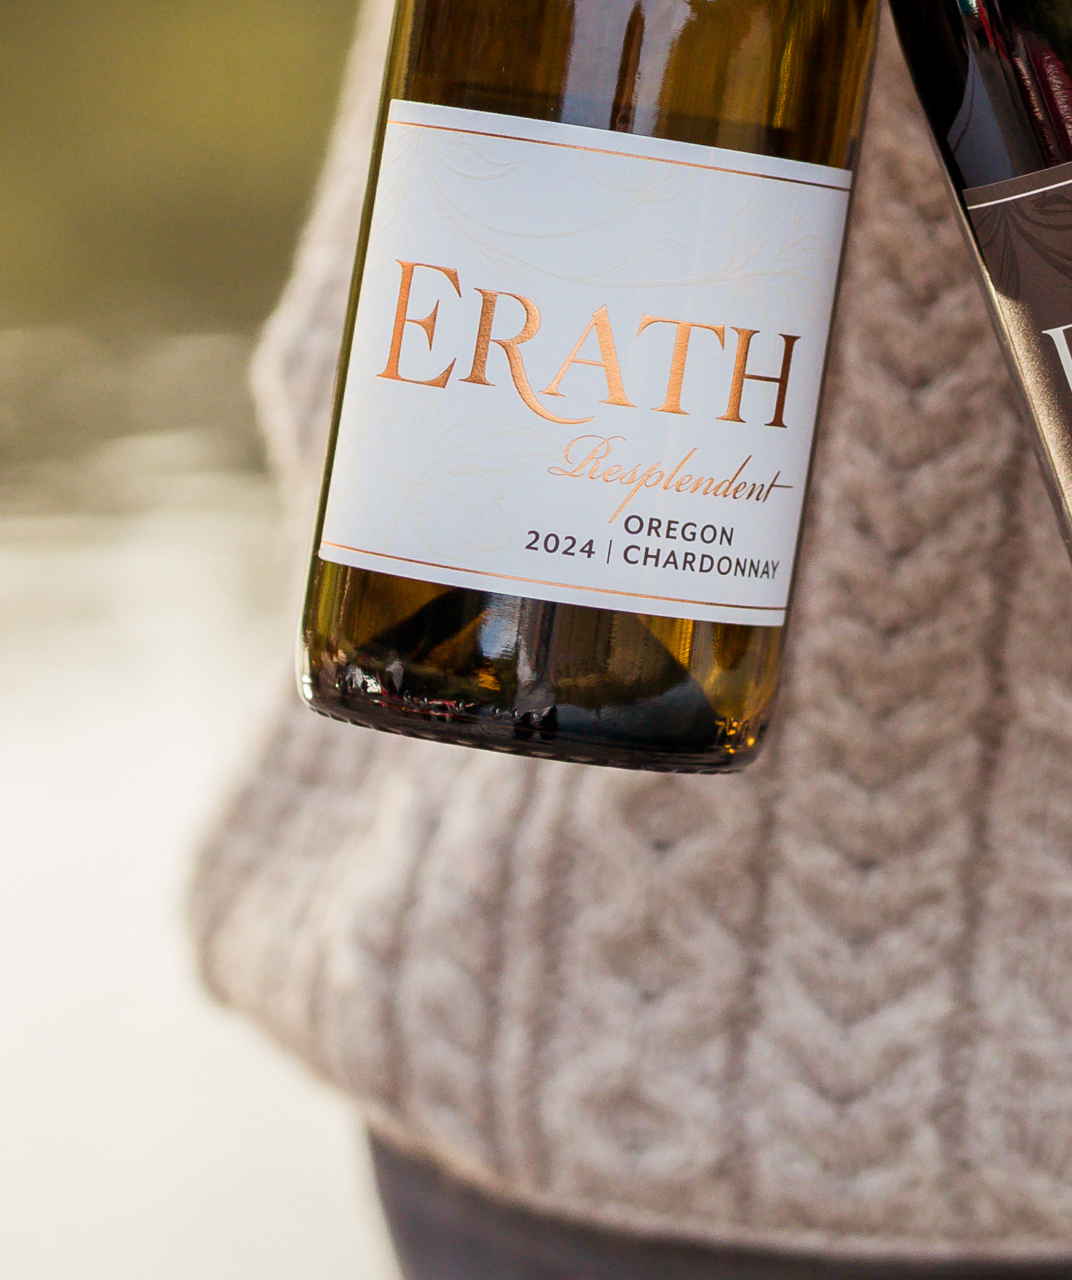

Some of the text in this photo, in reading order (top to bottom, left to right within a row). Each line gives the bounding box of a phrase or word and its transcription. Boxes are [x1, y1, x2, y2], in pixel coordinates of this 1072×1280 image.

[376, 258, 801, 428] ERATH
[547, 434, 794, 524] Resplendent
[524, 530, 780, 580] 2024 CHARDONNAY
[623, 514, 735, 547] OREGON
